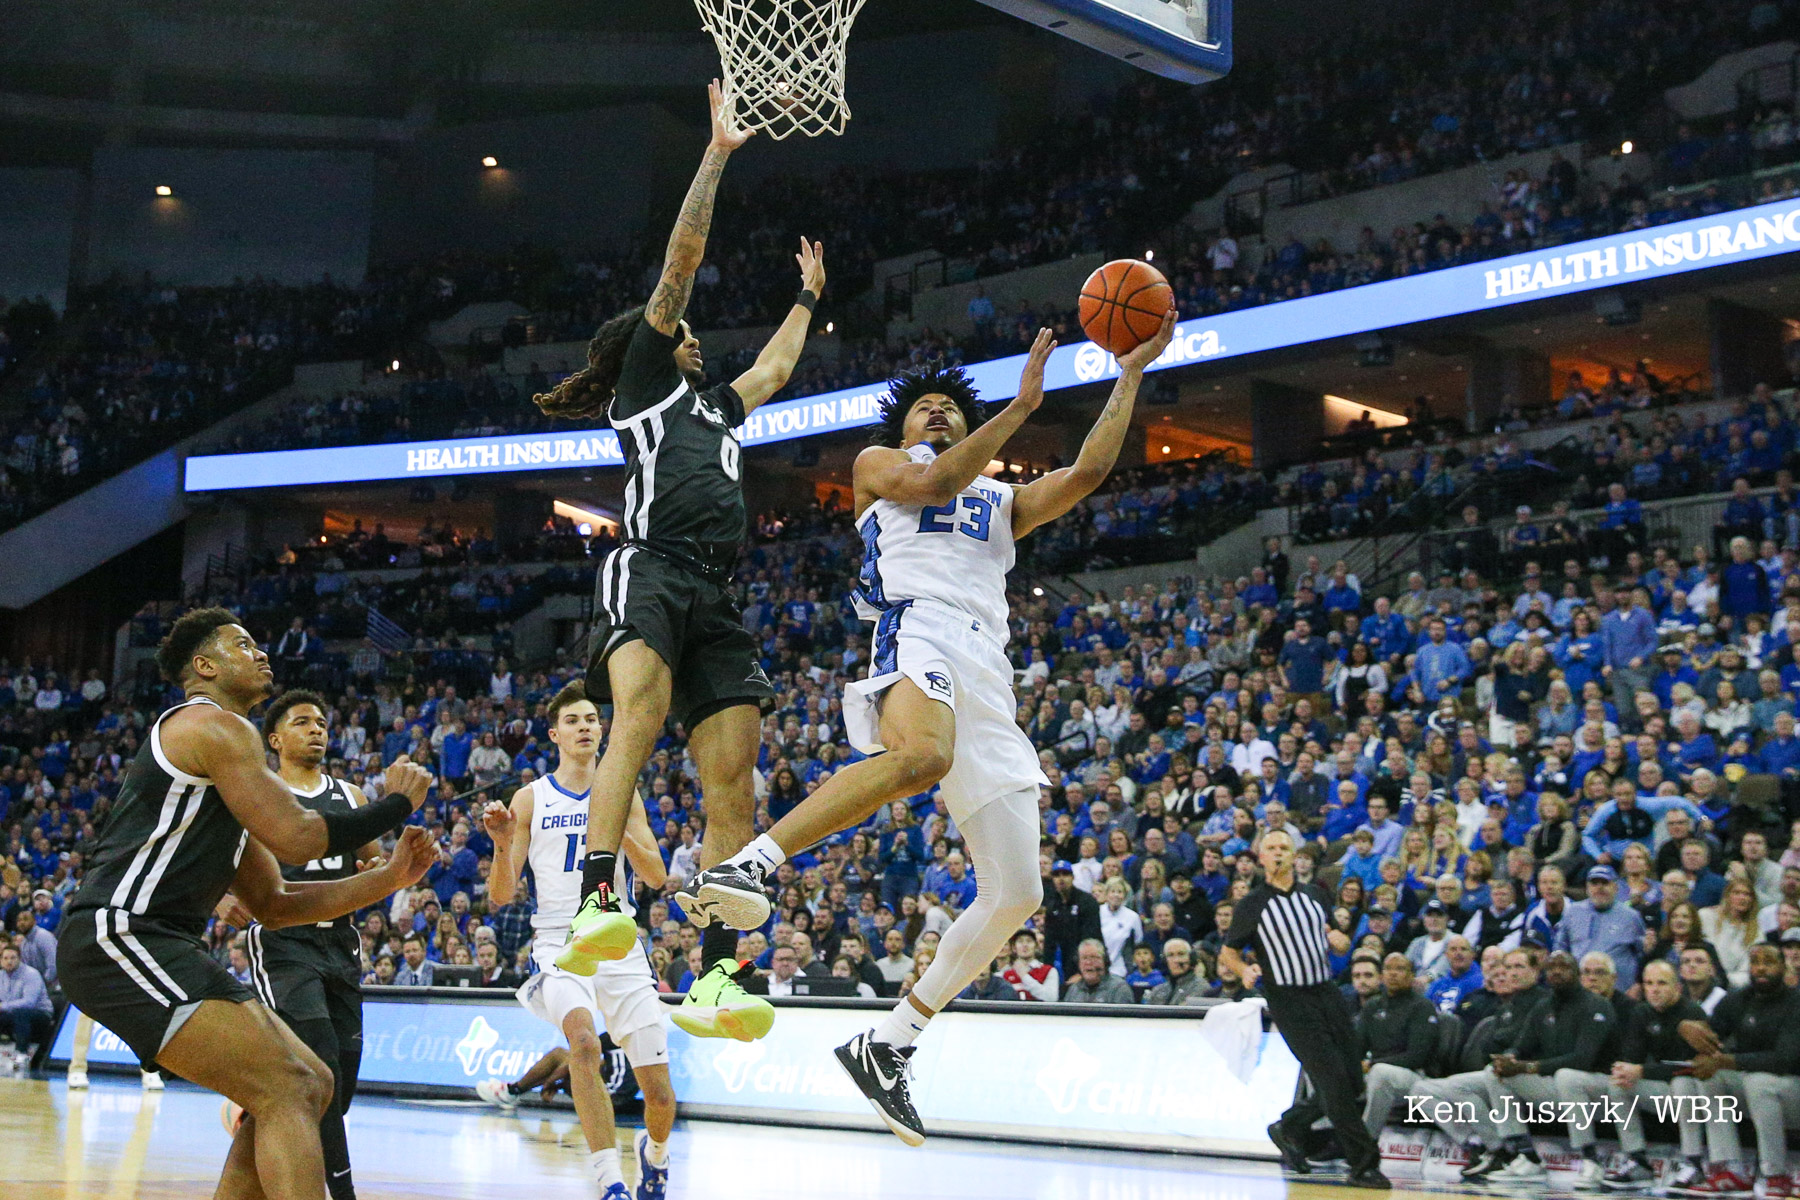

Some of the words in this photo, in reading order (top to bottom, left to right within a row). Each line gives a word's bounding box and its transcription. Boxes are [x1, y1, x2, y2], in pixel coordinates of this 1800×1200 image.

[1485, 247, 1619, 299] HEALTH
[765, 402, 810, 436] YOU
[812, 400, 839, 428] IN
[840, 390, 897, 422] MIN
[406, 444, 499, 471] HEALTH
[720, 434, 740, 482] 0
[915, 495, 992, 542] 23
[486, 1049, 524, 1077] CHI
[753, 1064, 800, 1094] CHI
[800, 1066, 862, 1098] Hea
[1088, 1080, 1144, 1115] CHI
